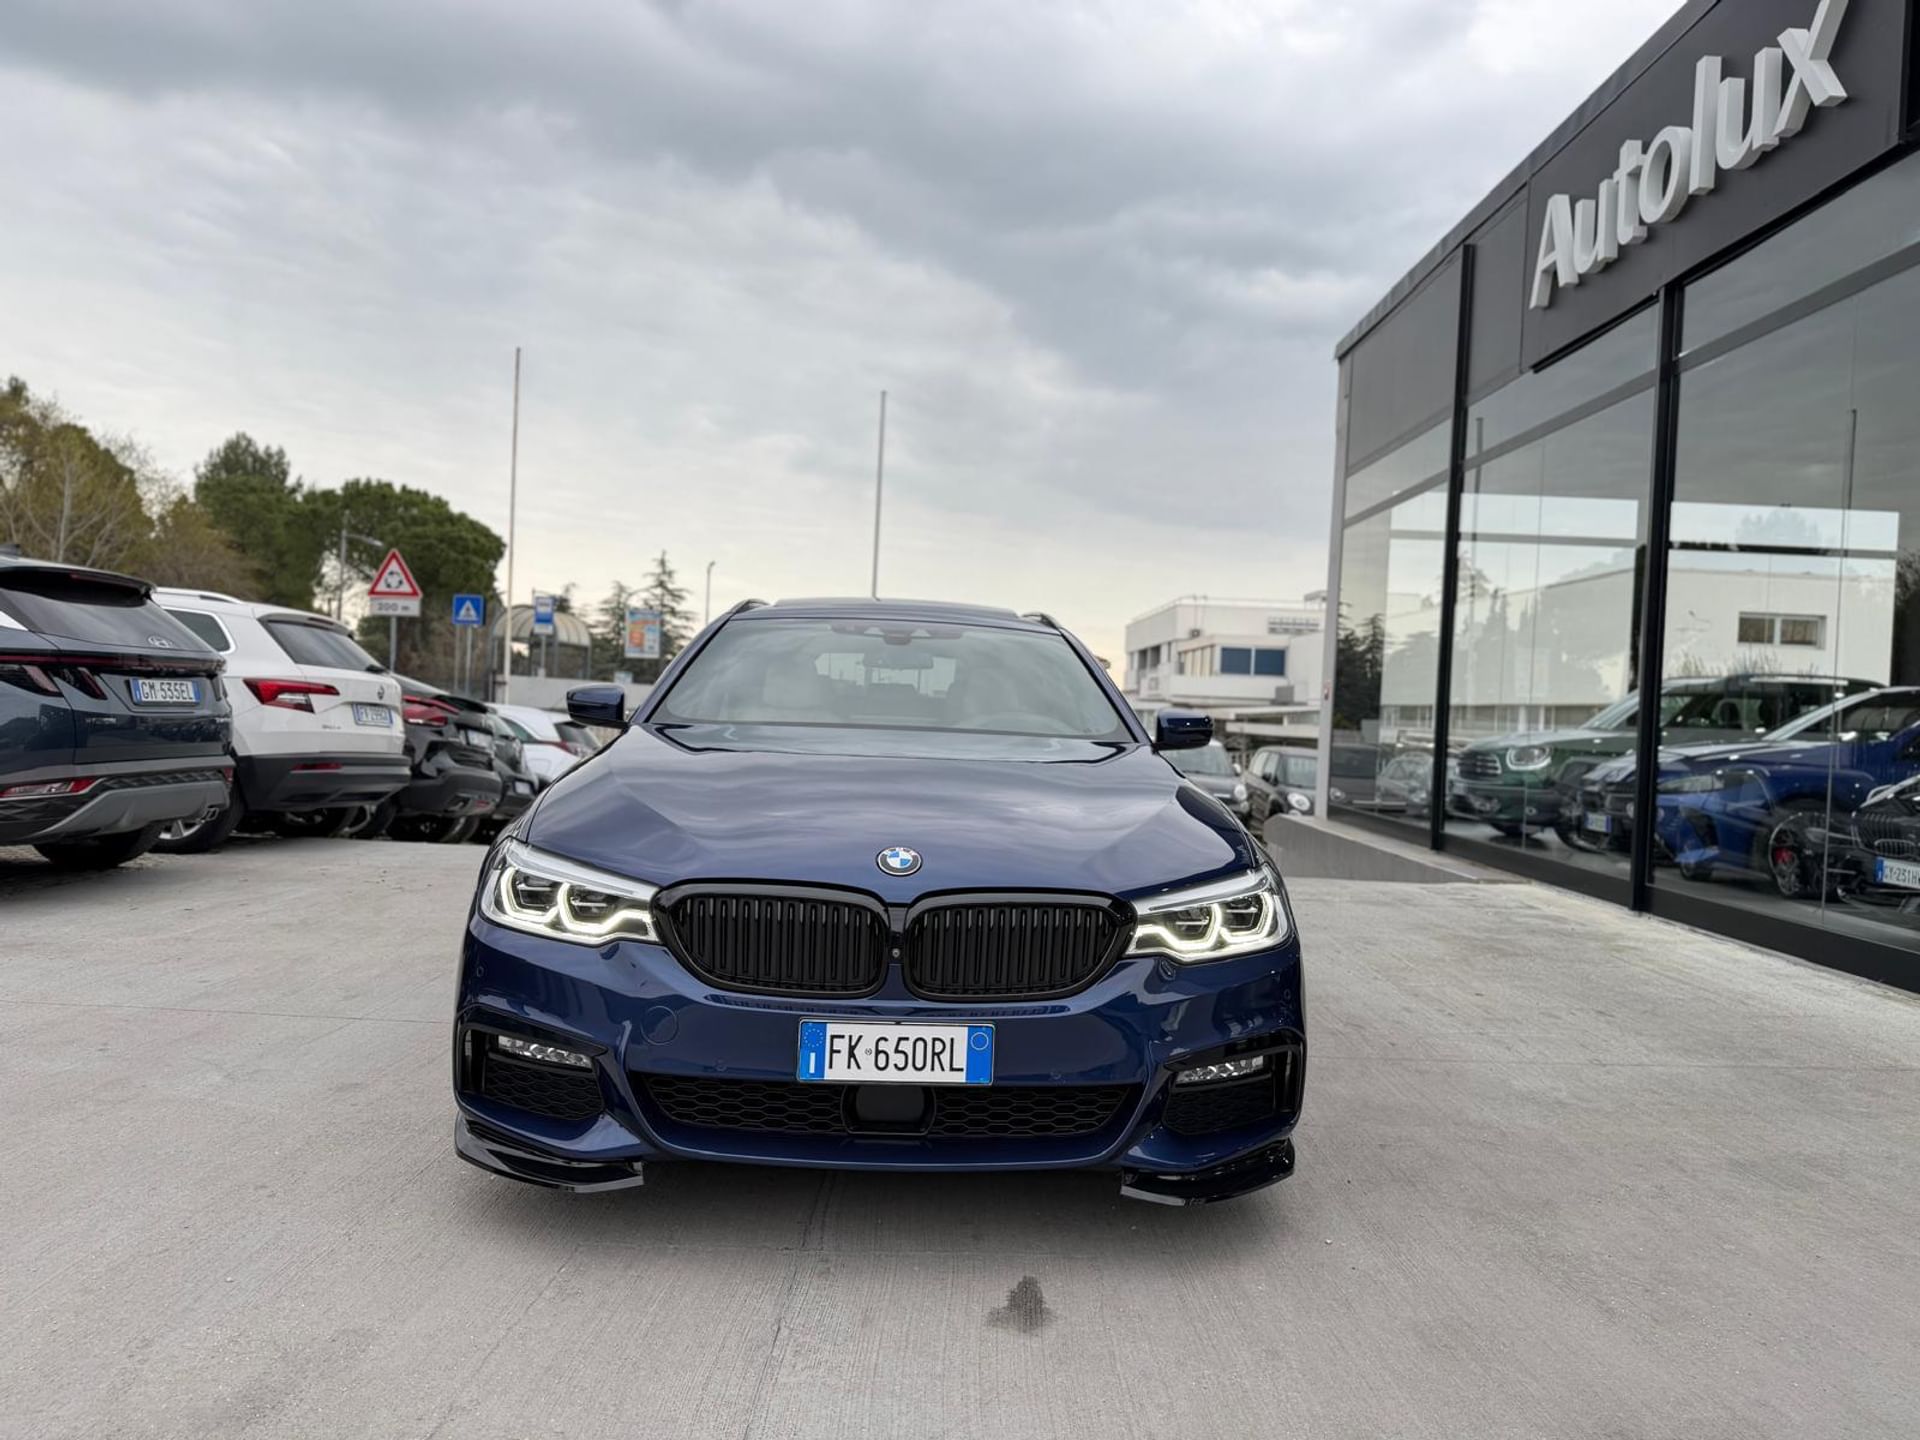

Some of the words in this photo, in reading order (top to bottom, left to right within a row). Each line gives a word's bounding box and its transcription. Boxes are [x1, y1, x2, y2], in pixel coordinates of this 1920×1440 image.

[1529, 0, 1848, 309] Autolux
[828, 1034, 863, 1070] FK
[874, 1036, 964, 1072] 650RL
